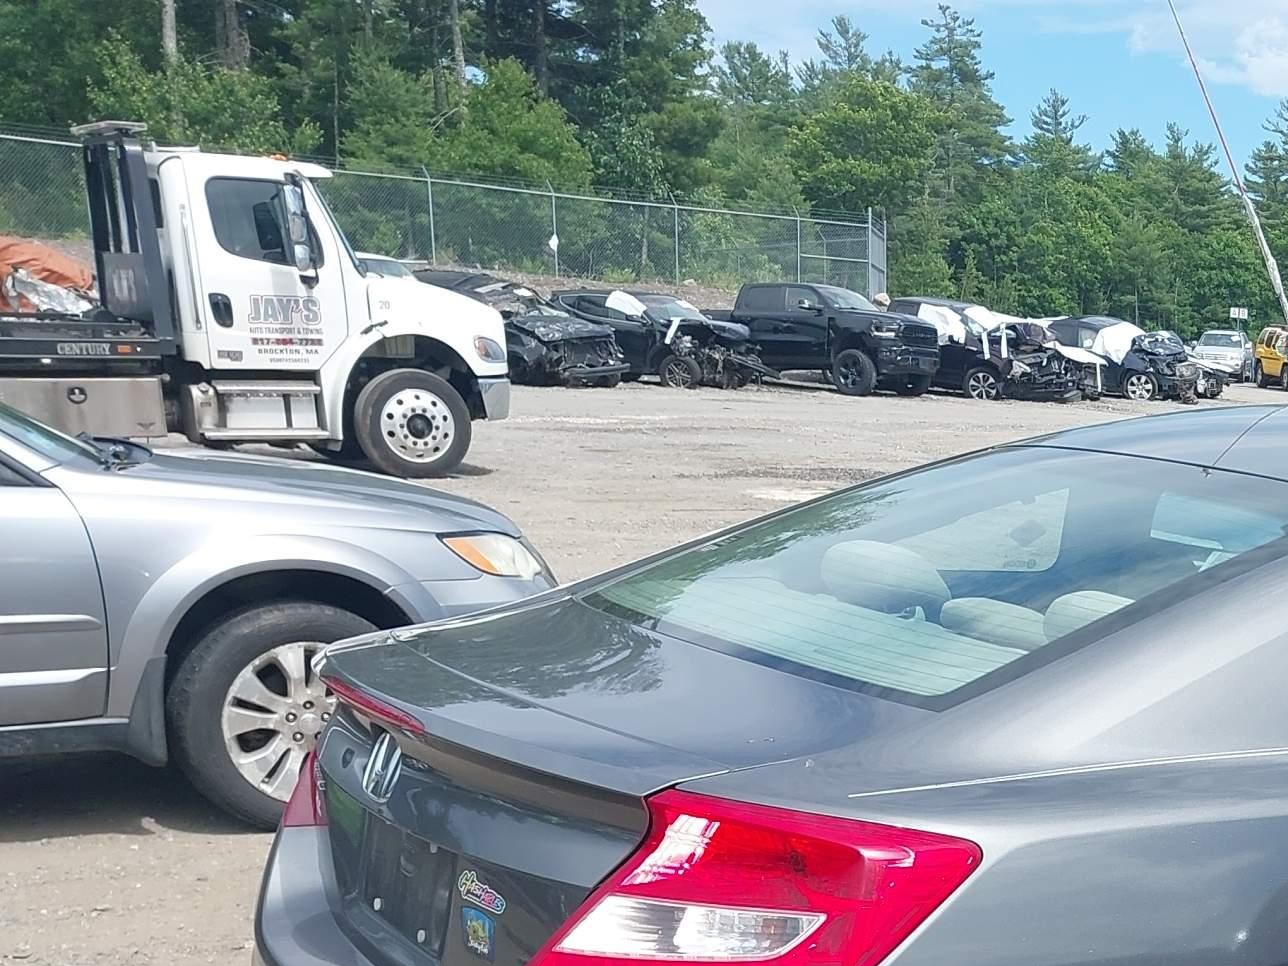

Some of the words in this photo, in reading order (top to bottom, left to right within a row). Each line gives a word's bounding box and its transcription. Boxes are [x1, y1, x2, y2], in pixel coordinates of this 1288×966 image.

[248, 295, 321, 325] JAY'S
[264, 327, 296, 335] TRANSPORT
[56, 342, 112, 355] CENTURY
